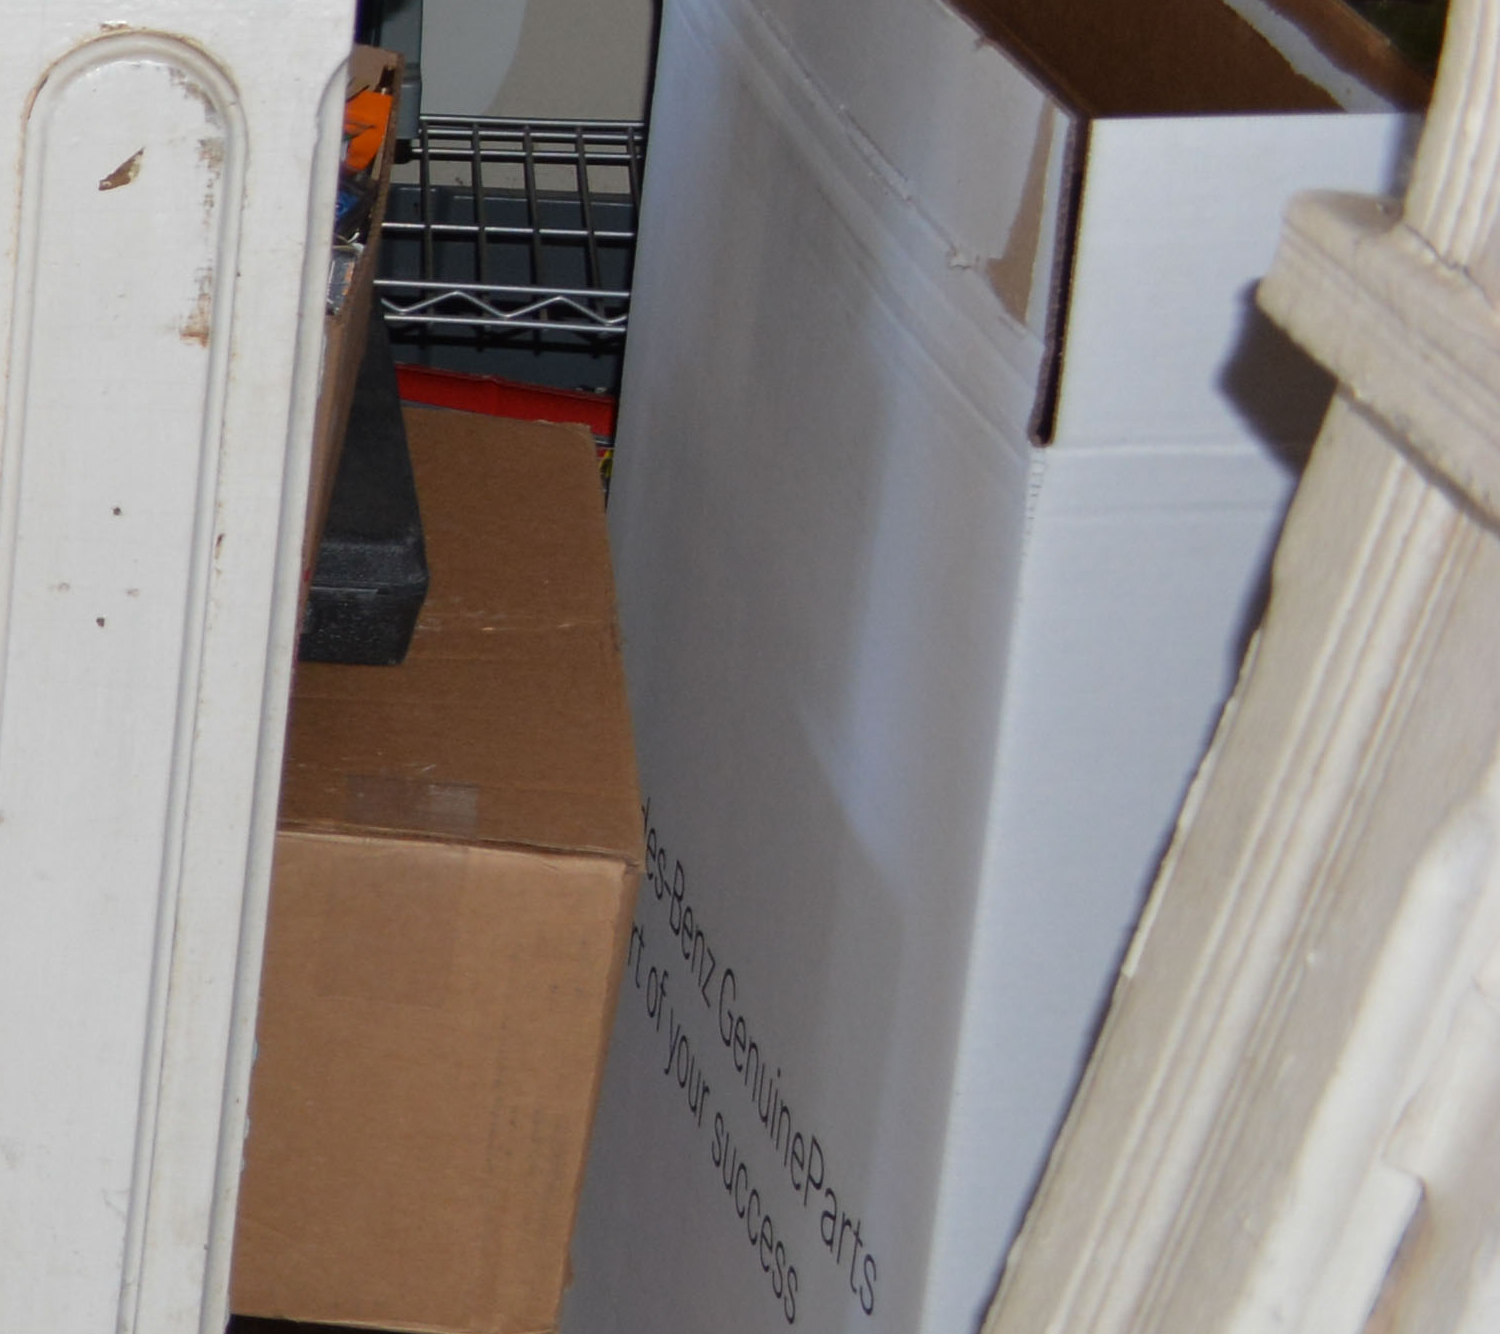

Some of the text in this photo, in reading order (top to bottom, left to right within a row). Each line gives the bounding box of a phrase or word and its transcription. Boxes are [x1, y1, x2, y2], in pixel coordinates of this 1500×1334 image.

[647, 966, 669, 1033] of
[664, 1007, 710, 1128] your
[712, 1112, 799, 1326] success
